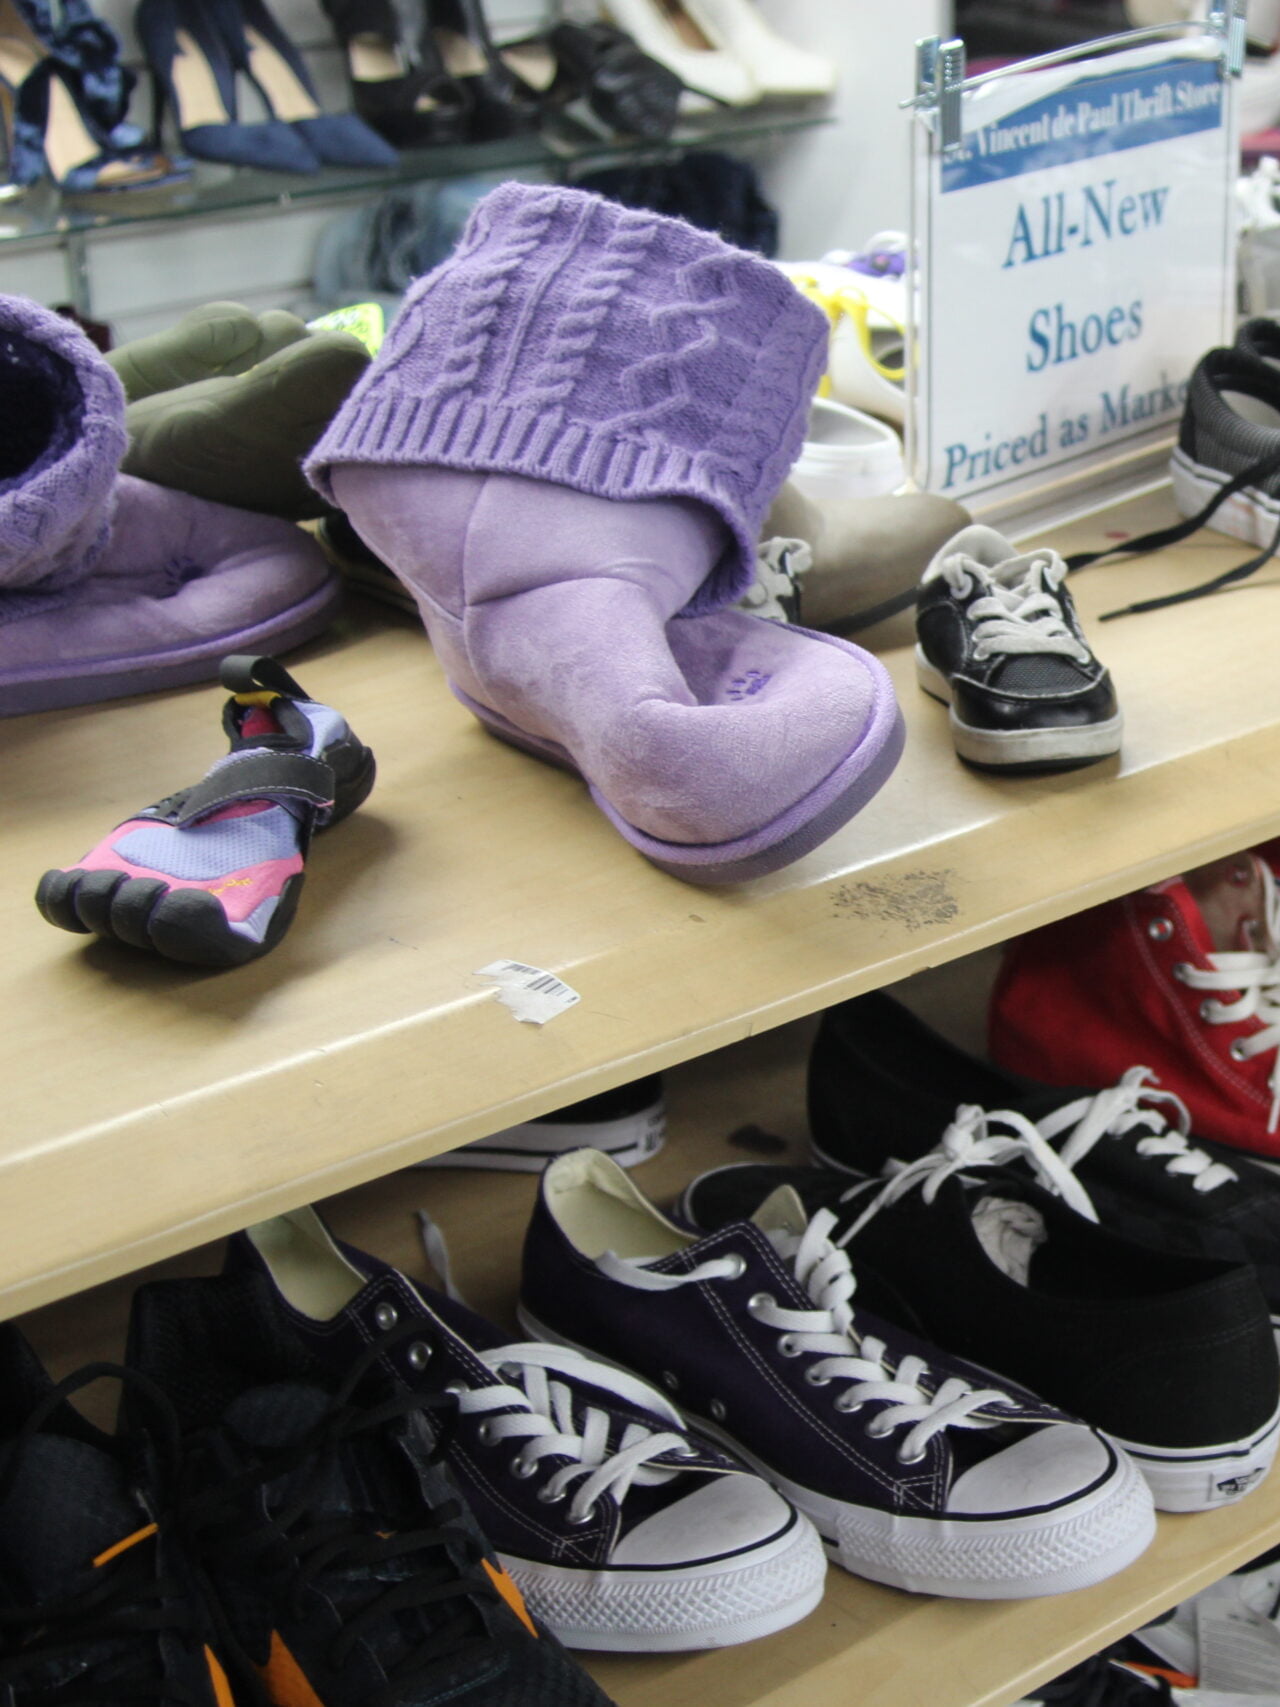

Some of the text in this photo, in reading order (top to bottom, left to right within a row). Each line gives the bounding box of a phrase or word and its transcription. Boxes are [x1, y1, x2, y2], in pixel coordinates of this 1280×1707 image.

[977, 113, 1049, 156] Vincent
[1052, 104, 1075, 139] de
[1078, 94, 1119, 135] Paul
[1121, 82, 1173, 123] Thrift
[1176, 80, 1221, 111] Store
[1002, 179, 1169, 269] All-New
[1026, 299, 1143, 373] Shoes
[942, 370, 1189, 490] Priced as Marke
